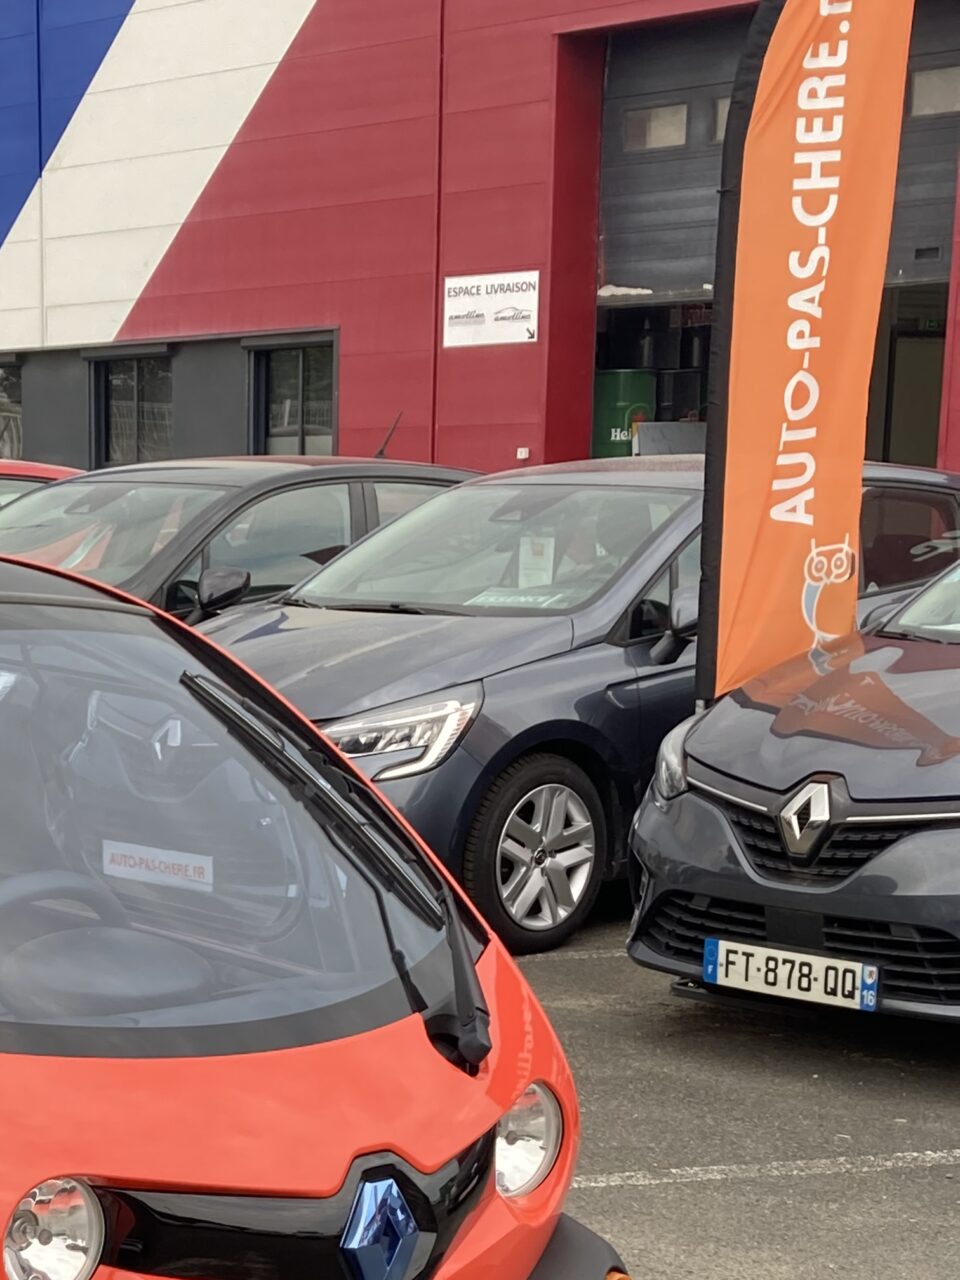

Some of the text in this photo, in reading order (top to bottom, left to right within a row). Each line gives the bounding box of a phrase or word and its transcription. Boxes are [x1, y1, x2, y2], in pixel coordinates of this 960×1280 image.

[447, 280, 536, 297] ESPACE LIVRAISON
[861, 989, 876, 1007] 16
